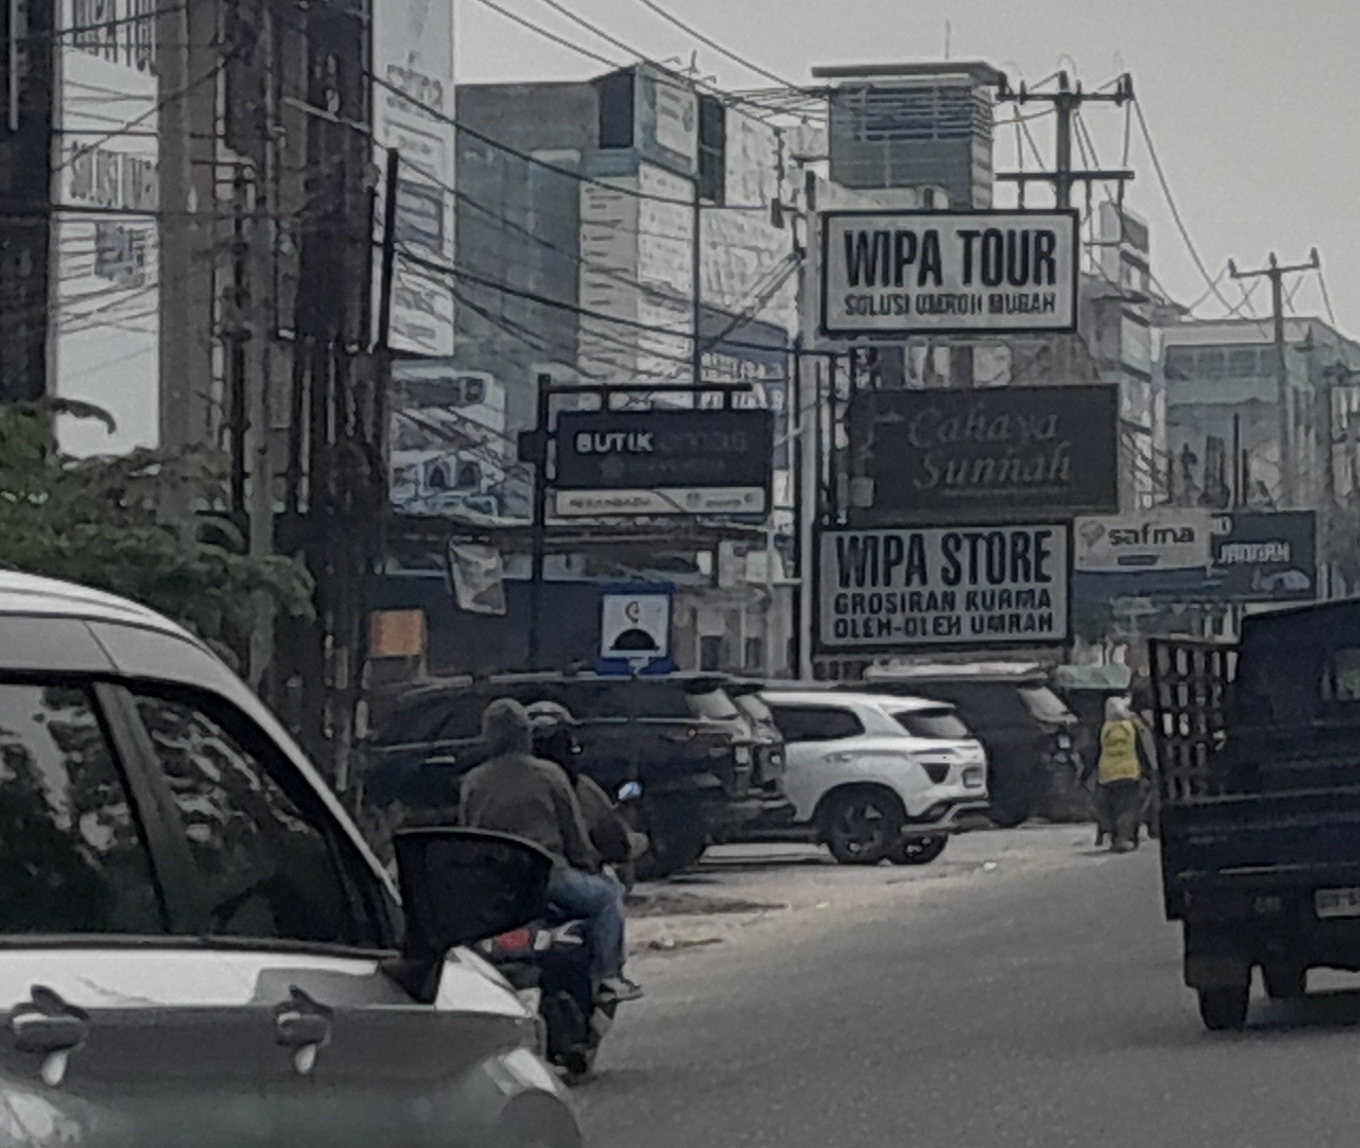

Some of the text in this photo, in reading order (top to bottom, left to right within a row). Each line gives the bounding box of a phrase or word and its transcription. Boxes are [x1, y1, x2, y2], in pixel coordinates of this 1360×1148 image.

[845, 228, 1057, 287] WIPA TOUR
[844, 293, 910, 316] SOLUSI
[576, 431, 653, 452] BUTIK
[908, 403, 1058, 449] Cahaya
[914, 440, 1071, 489] Sunnah
[835, 530, 1053, 589] WIPA STORE
[834, 588, 1053, 614] GROSIRAN KURMA
[834, 615, 961, 639] OLEH-OLEH
